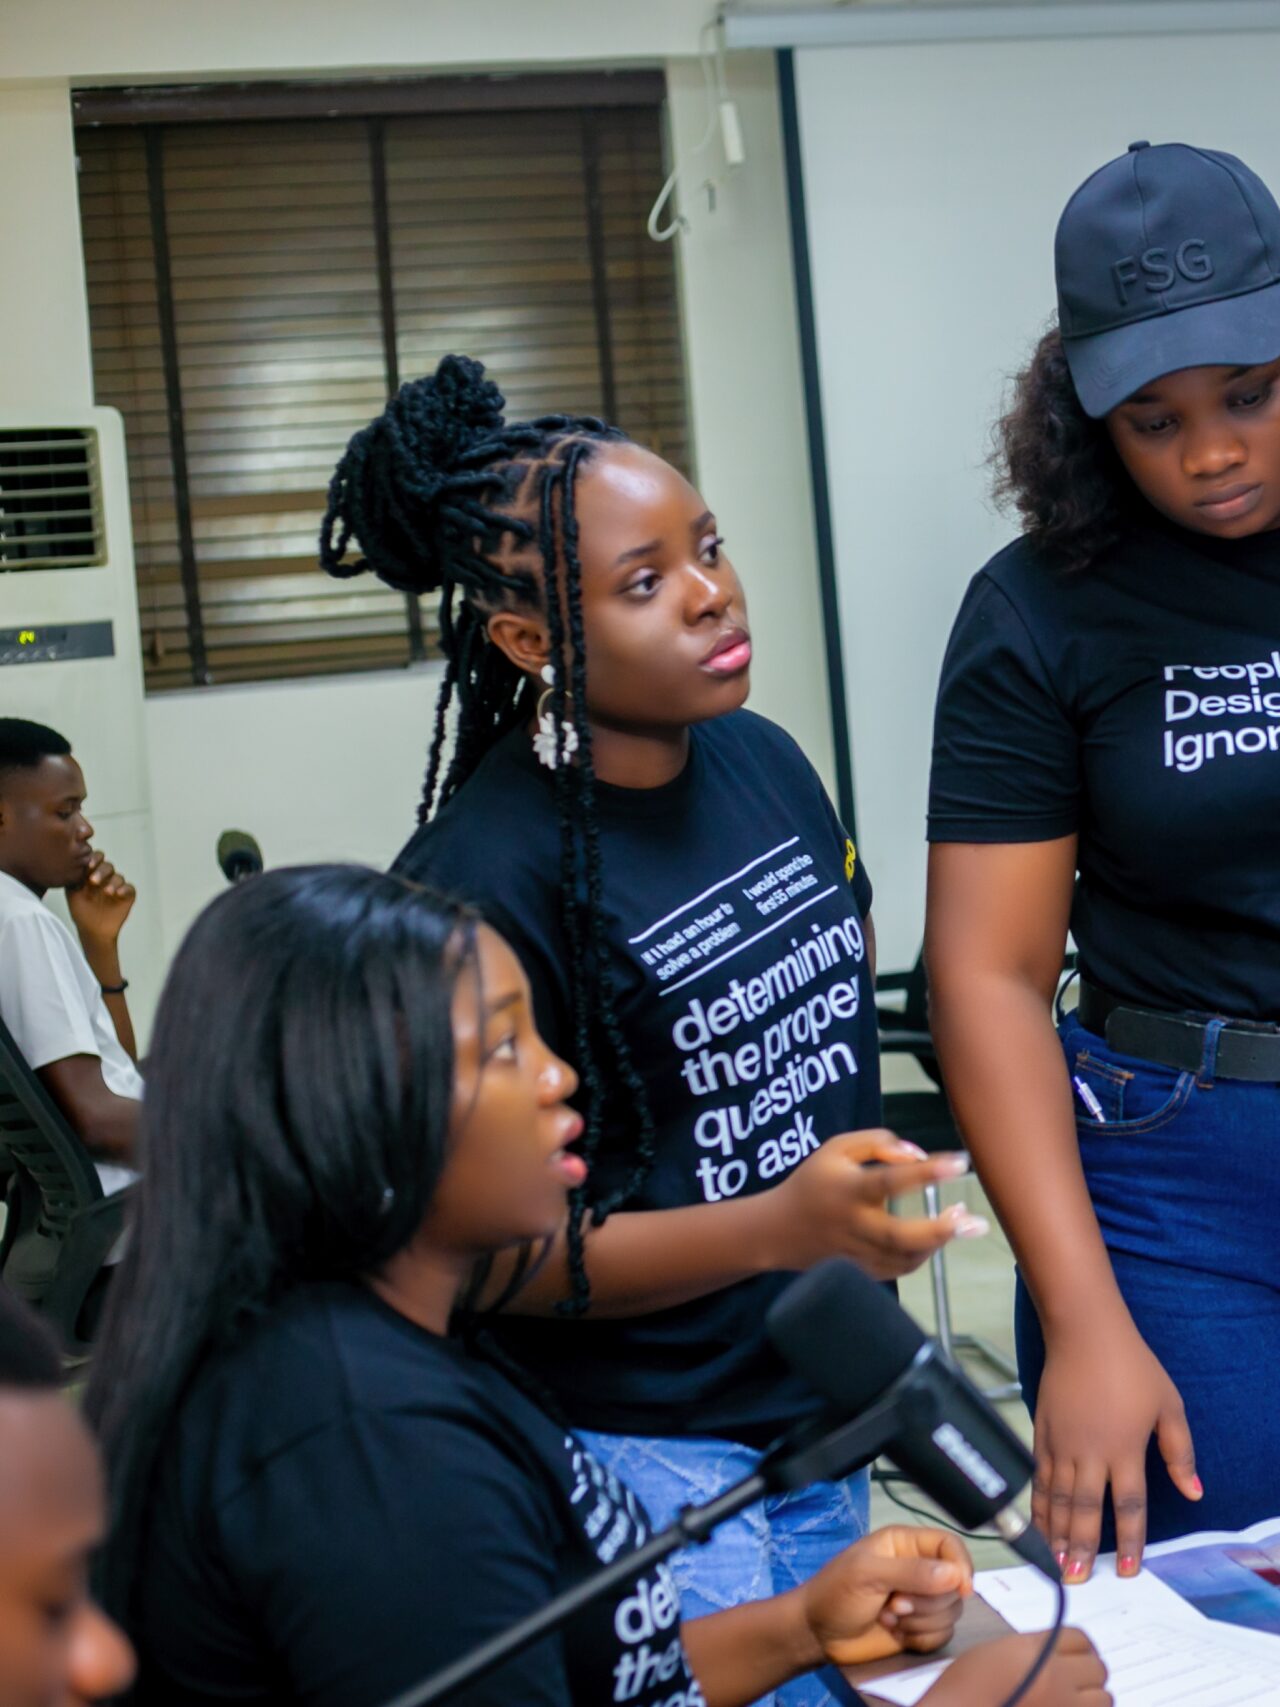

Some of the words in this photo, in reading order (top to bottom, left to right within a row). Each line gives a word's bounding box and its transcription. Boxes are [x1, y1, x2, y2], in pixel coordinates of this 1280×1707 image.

[1110, 238, 1215, 307] FSG
[655, 931, 688, 956] had
[682, 924, 702, 940] an
[694, 908, 726, 931] hour
[719, 902, 735, 916] to
[656, 952, 693, 981] solve
[688, 946, 702, 959] a
[697, 922, 742, 957] problem
[672, 915, 865, 1052] determining
[680, 1048, 762, 1097] the
[693, 1042, 859, 1157] question
[695, 1156, 749, 1203] to
[757, 1111, 822, 1180] ask
